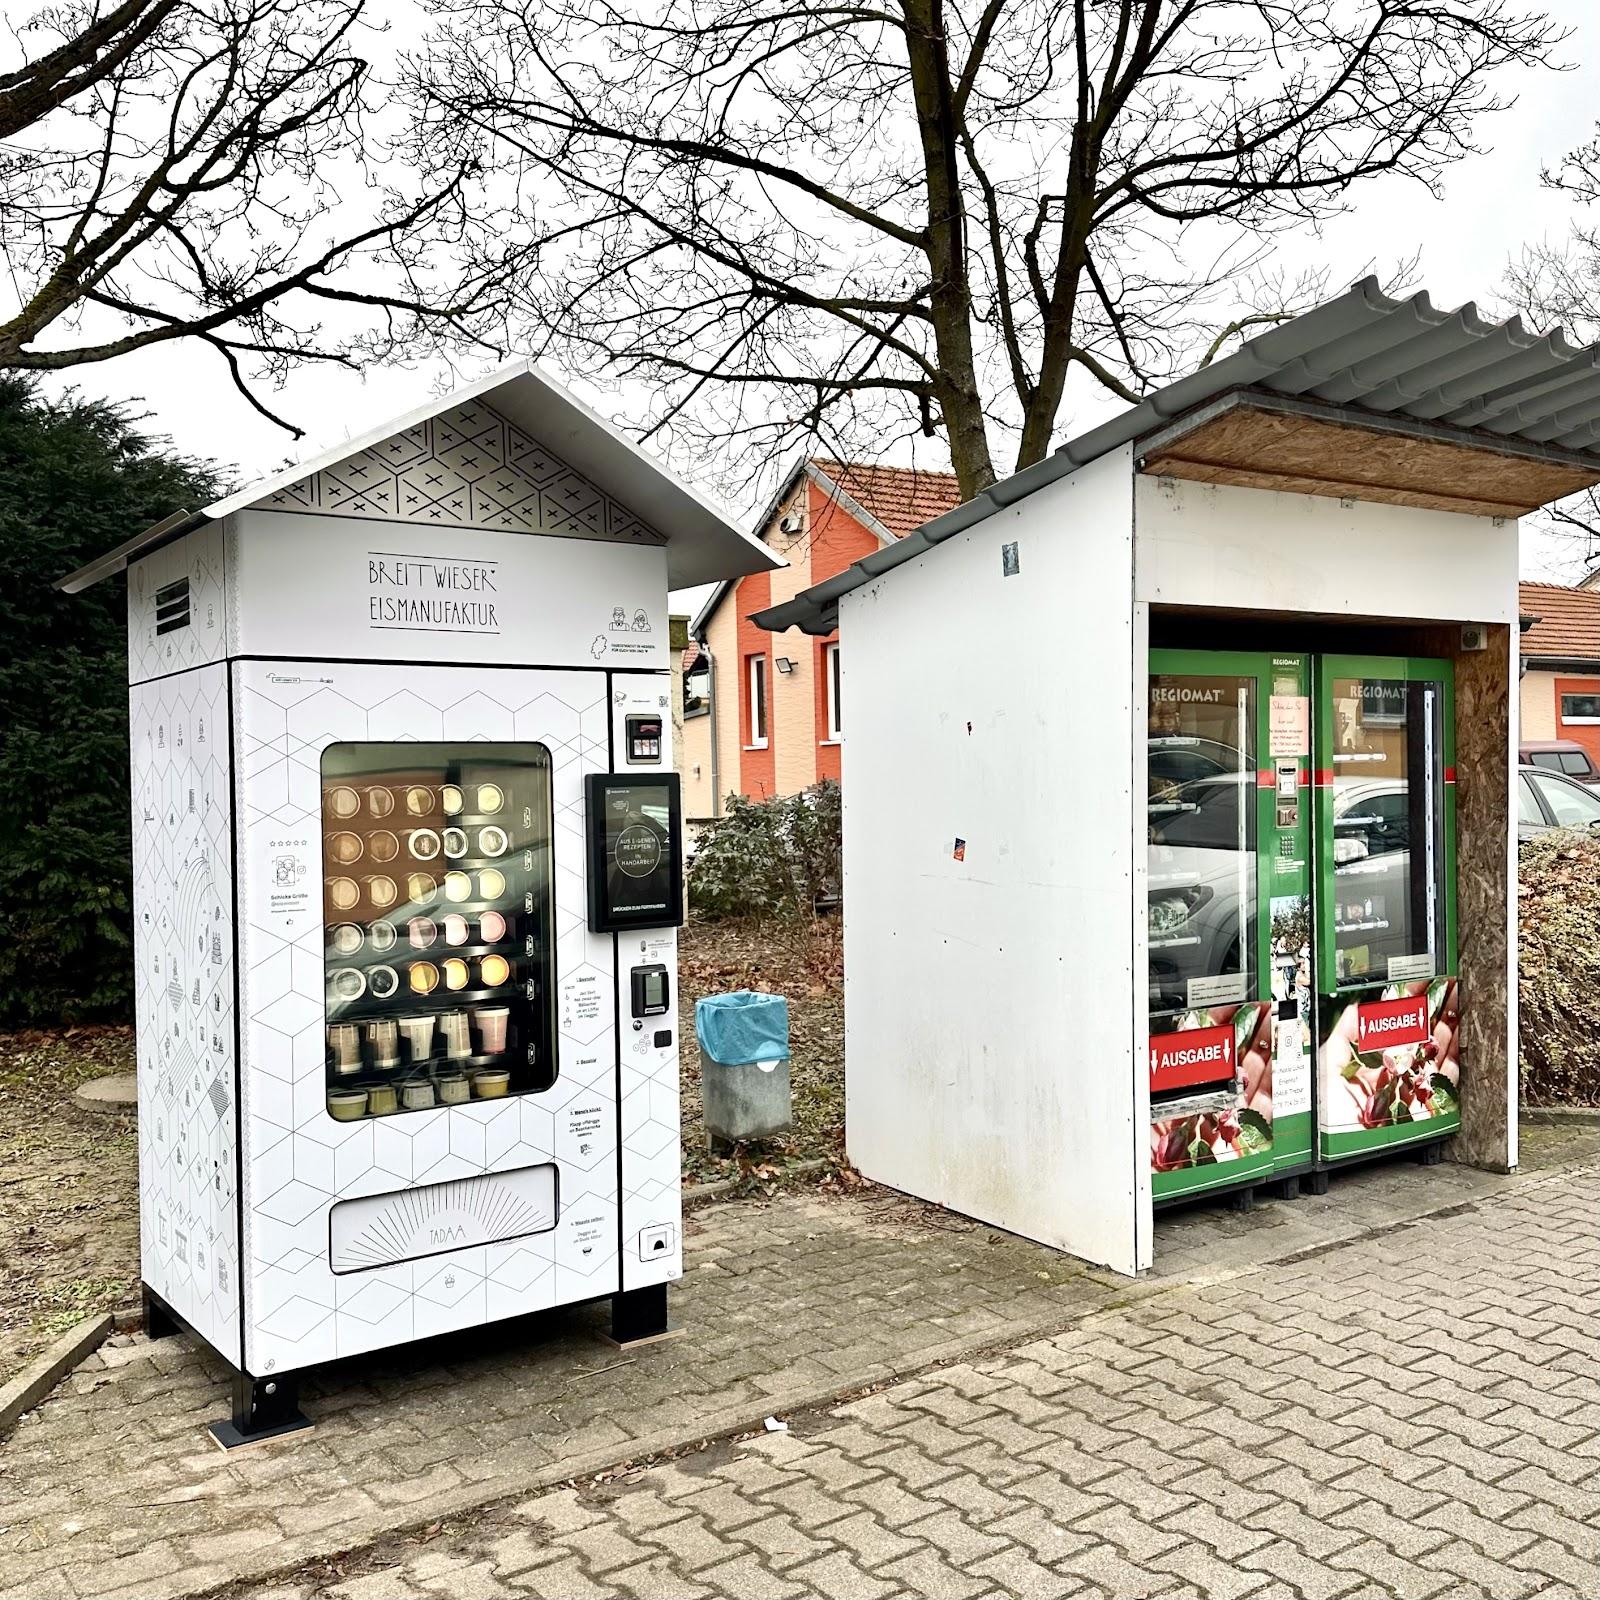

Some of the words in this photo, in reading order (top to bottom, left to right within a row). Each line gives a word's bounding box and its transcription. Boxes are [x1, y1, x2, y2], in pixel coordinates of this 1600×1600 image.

[370, 596, 498, 626] EISMANUFAKTUR
[1273, 658, 1300, 666] REGIOMAT
[1368, 1012, 1418, 1034] AUSGABE
[1160, 1045, 1221, 1069] AUSGABE
[430, 1224, 466, 1245] TADAA
